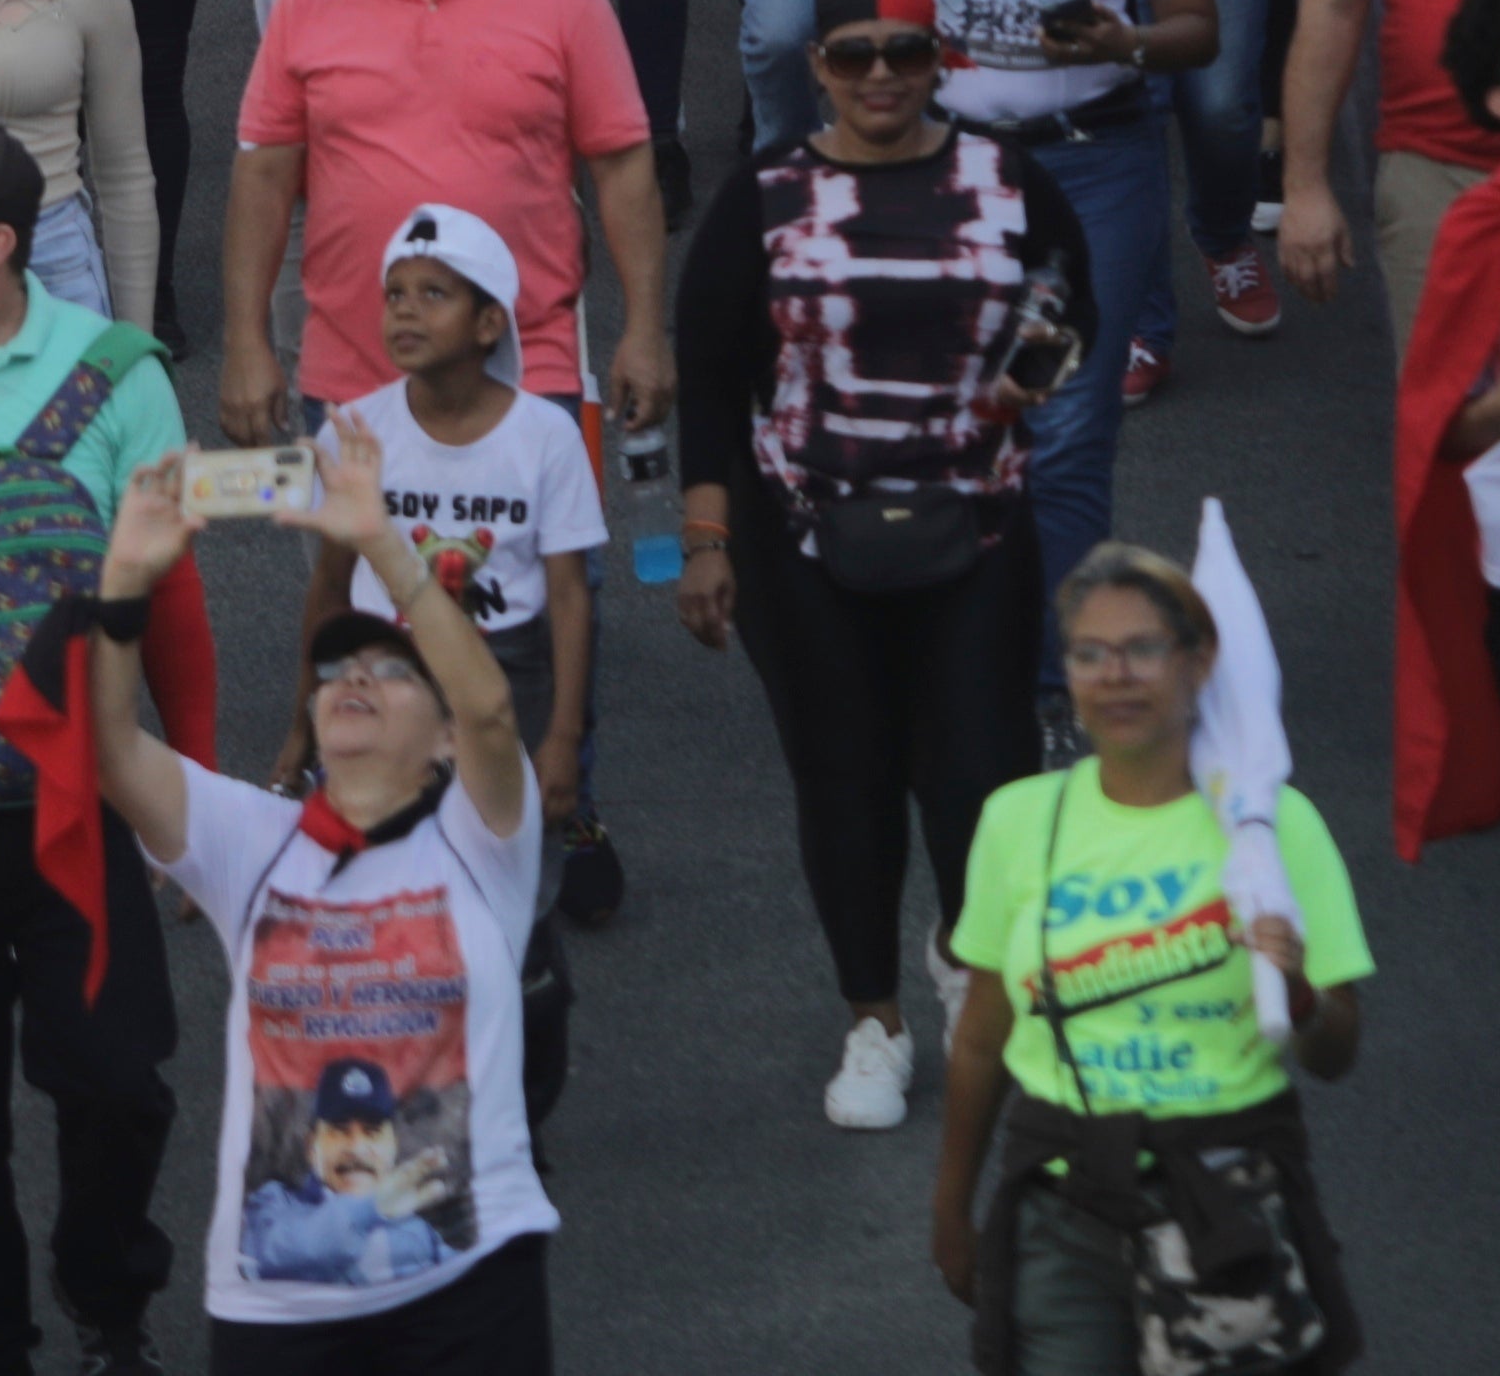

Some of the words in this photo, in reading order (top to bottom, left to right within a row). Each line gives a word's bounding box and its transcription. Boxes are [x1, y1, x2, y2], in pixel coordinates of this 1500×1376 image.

[384, 489, 439, 519] SOY
[452, 494, 528, 525] SAPO
[1045, 860, 1210, 931] Soy
